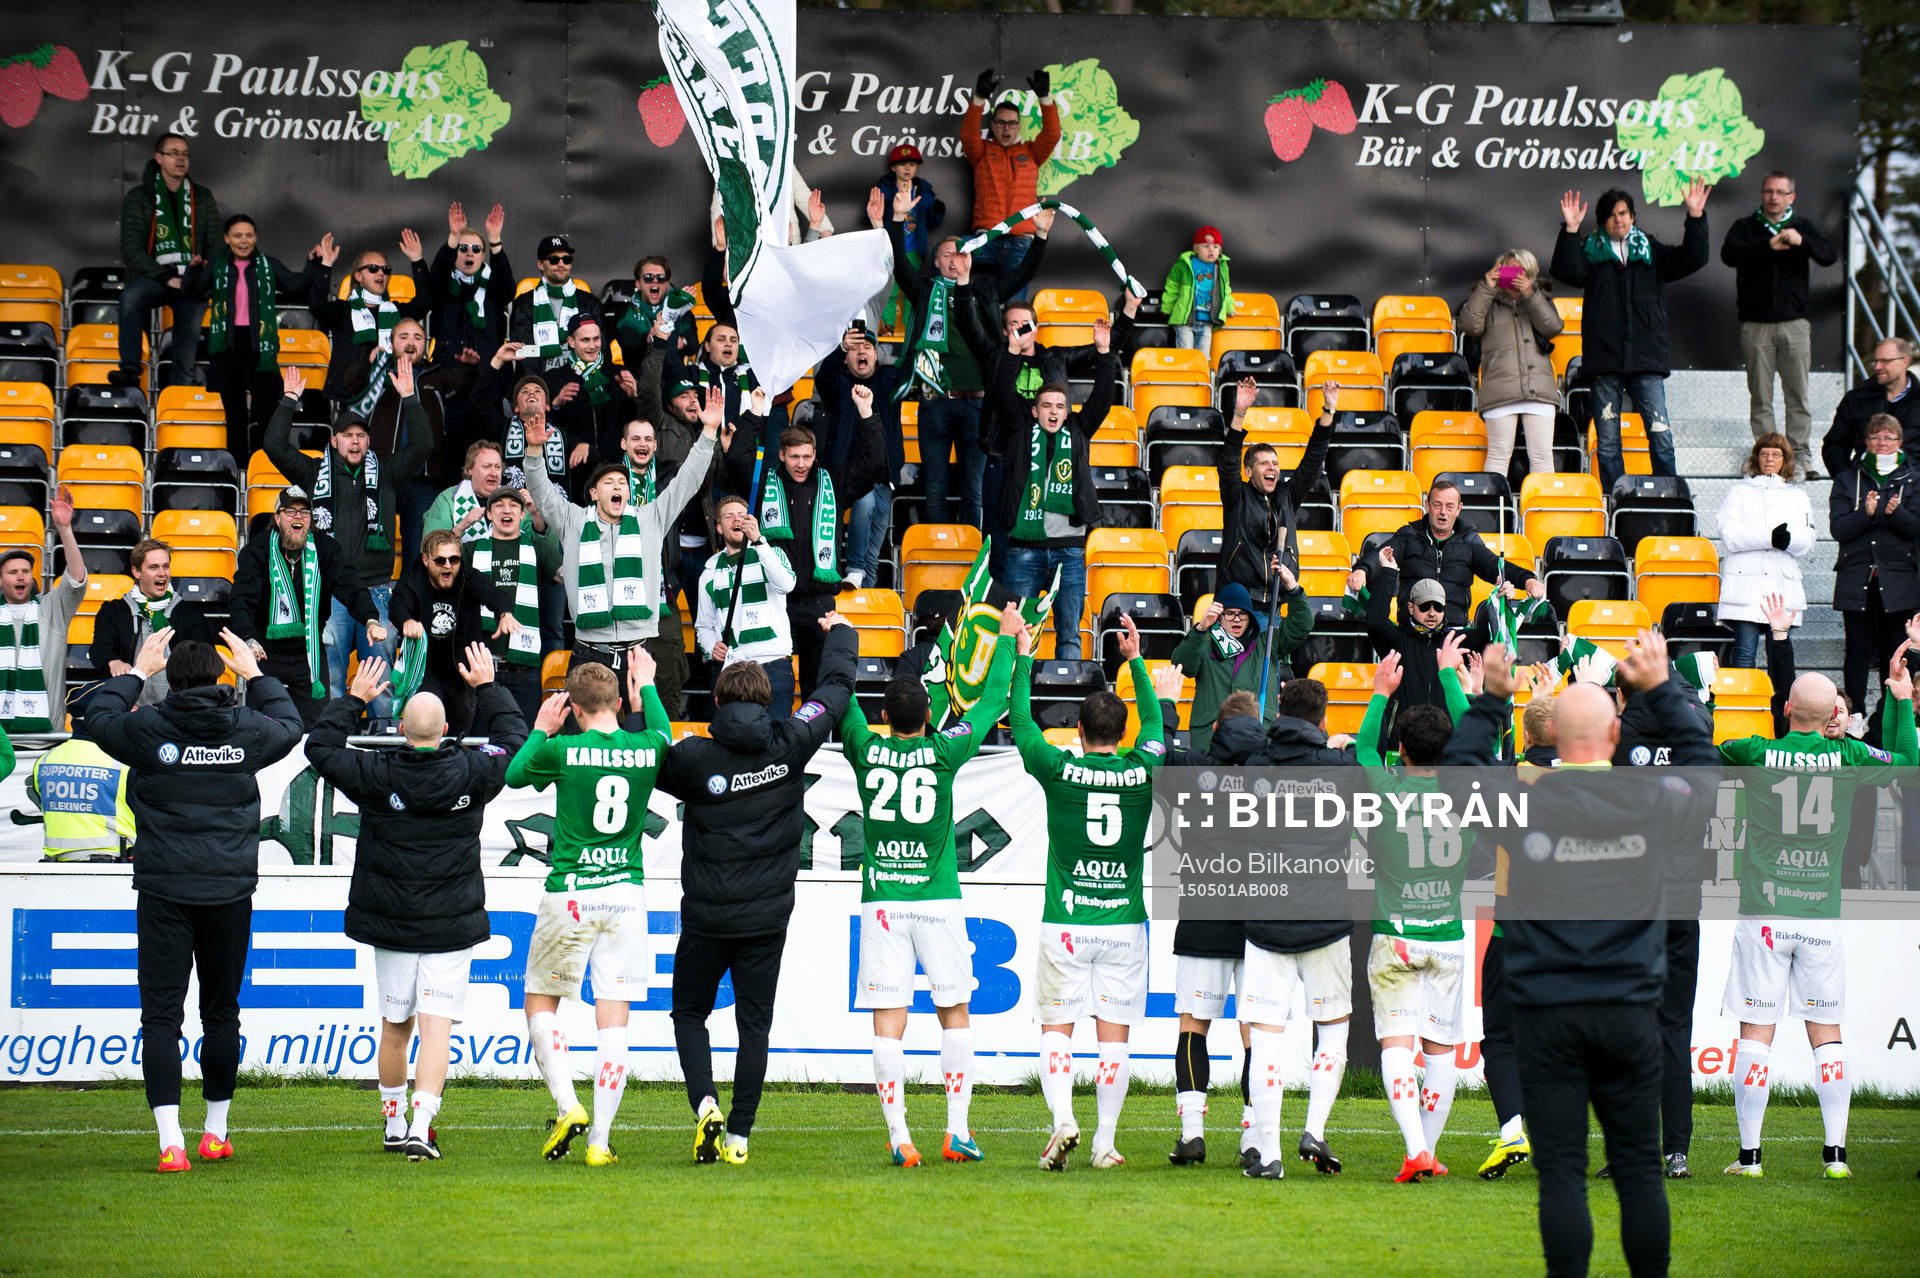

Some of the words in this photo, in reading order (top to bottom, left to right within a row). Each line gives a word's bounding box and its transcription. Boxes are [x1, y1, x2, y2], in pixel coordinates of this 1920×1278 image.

[90, 49, 193, 94] K-G
[202, 52, 444, 99] Paulssons
[1358, 83, 1456, 126] K-G
[1465, 84, 1699, 128] Paulssons
[89, 103, 160, 137] Bär
[169, 104, 199, 138] &
[214, 106, 400, 143] Grönsaker
[407, 113, 465, 144] AB
[808, 124, 837, 155] &
[1356, 135, 1422, 167] Bär
[1431, 135, 1461, 169] &
[1475, 137, 1654, 171] Grönsaker
[1662, 140, 1718, 171] AB
[184, 747, 242, 762] Atteviks
[566, 747, 656, 768] KARLSSON
[866, 744, 937, 768] CALISIR
[1765, 749, 1842, 772] NILSSON
[40, 765, 113, 780] SUPPORTER-
[732, 765, 787, 789] Atteviks
[1061, 762, 1147, 787] FENDRICH
[46, 781, 99, 801] POLIS
[865, 767, 938, 824] 26
[1277, 781, 1334, 795] Atteviks
[592, 775, 630, 834] 8
[1771, 775, 1834, 835] 14
[1086, 791, 1122, 847] 5
[875, 840, 929, 860] AQUA
[1396, 812, 1463, 868] 18
[577, 847, 628, 867] AQUA
[1775, 849, 1829, 868] AQUA
[1072, 859, 1128, 880] AQUA
[1401, 880, 1451, 900] AQUA
[1074, 895, 1130, 909] Riksbyggen
[889, 911, 946, 925] Riksbyggen
[1074, 935, 1131, 949] Riksbyggen
[1775, 931, 1832, 946] Riksbyggen
[1753, 998, 1776, 1008] Elmia
[1815, 998, 1839, 1008] Elmia
